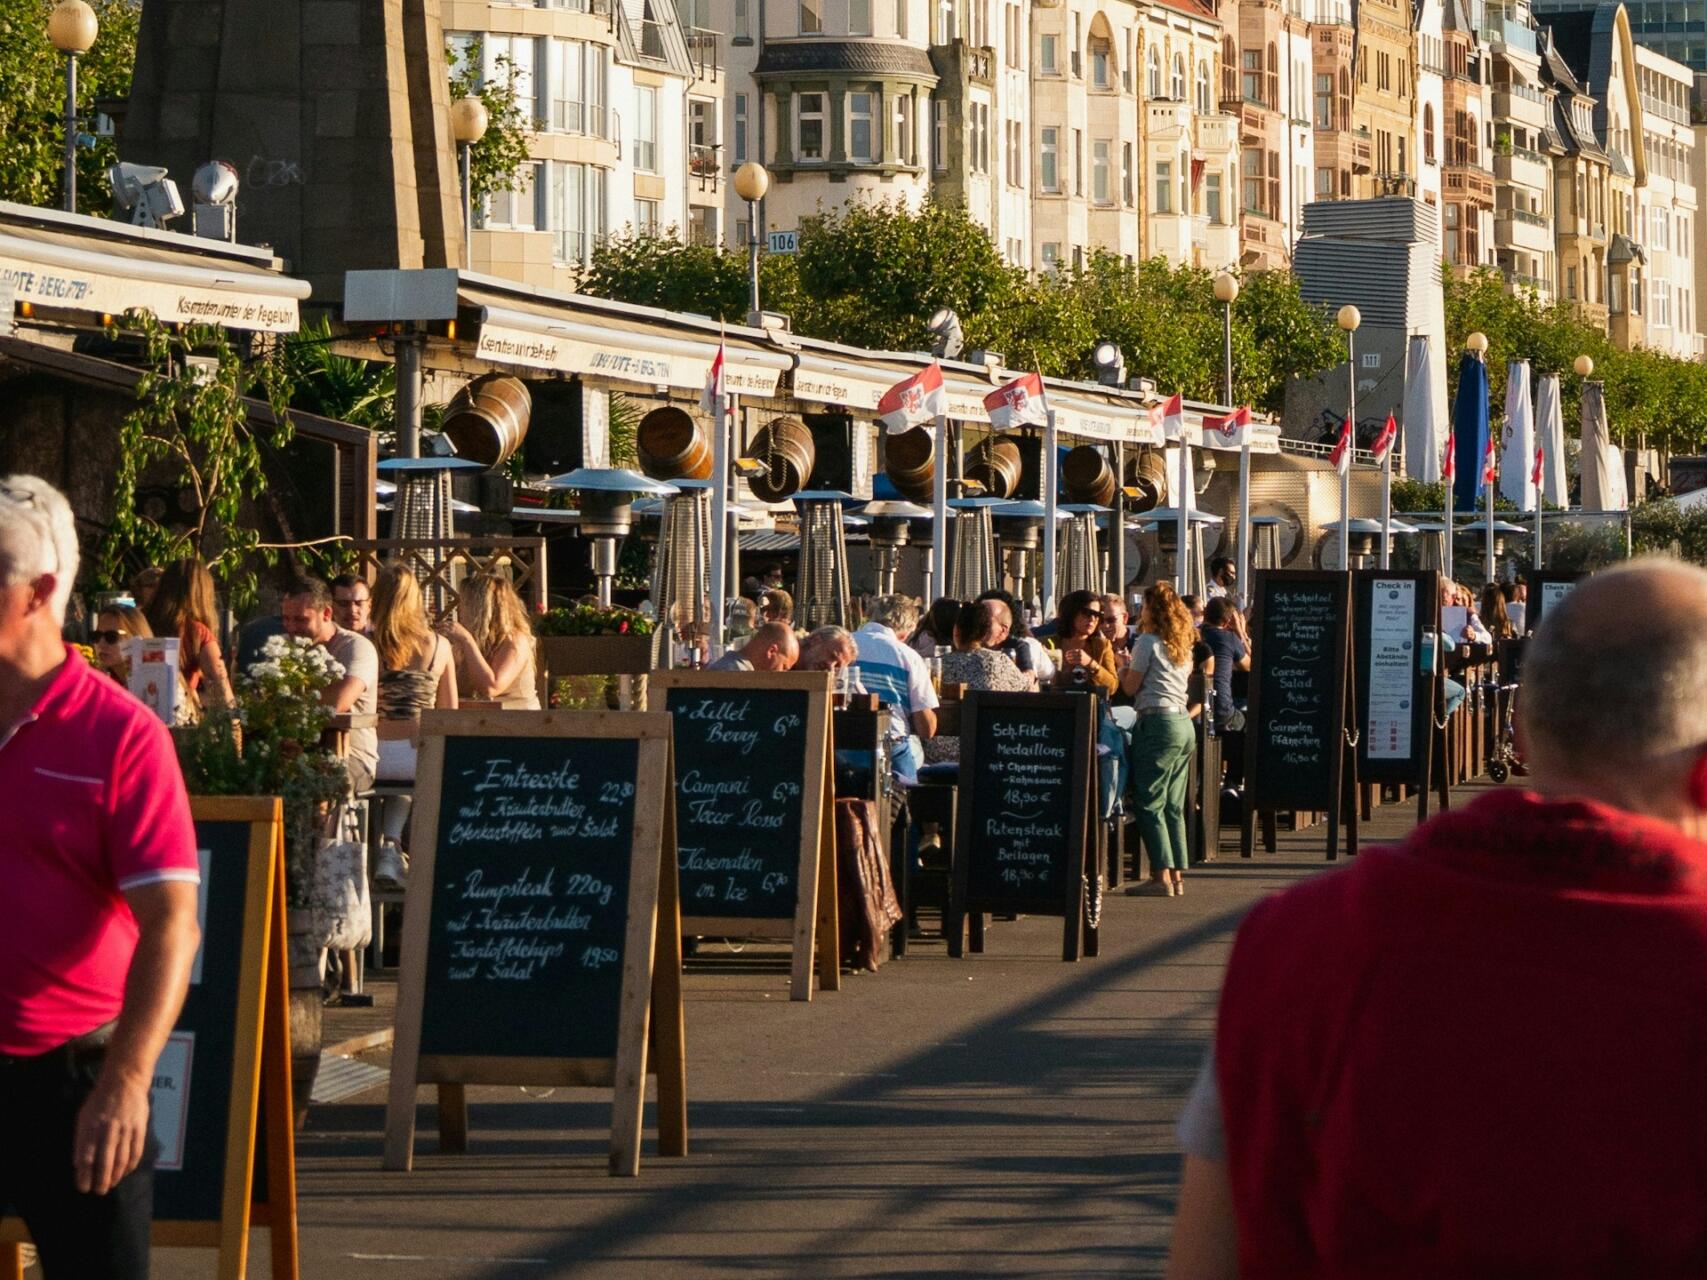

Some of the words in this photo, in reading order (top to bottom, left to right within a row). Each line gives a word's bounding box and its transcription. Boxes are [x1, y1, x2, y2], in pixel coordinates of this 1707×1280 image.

[772, 234, 794, 251] 106
[1280, 677, 1312, 688] Salad
[706, 722, 760, 755] Berry
[997, 743, 1065, 758] Medaillons
[459, 798, 482, 818] mit
[1003, 789, 1038, 808] 18,90
[1040, 792, 1052, 801] €
[551, 822, 577, 836] und
[578, 816, 619, 838] Salat
[986, 818, 1063, 837] Putensteak
[997, 847, 1051, 864] Beilagen
[462, 867, 555, 909] Rumpsteak
[724, 876, 749, 901] Ice
[447, 911, 472, 932] mit
[448, 963, 477, 979] und
[486, 960, 535, 980] Salat
